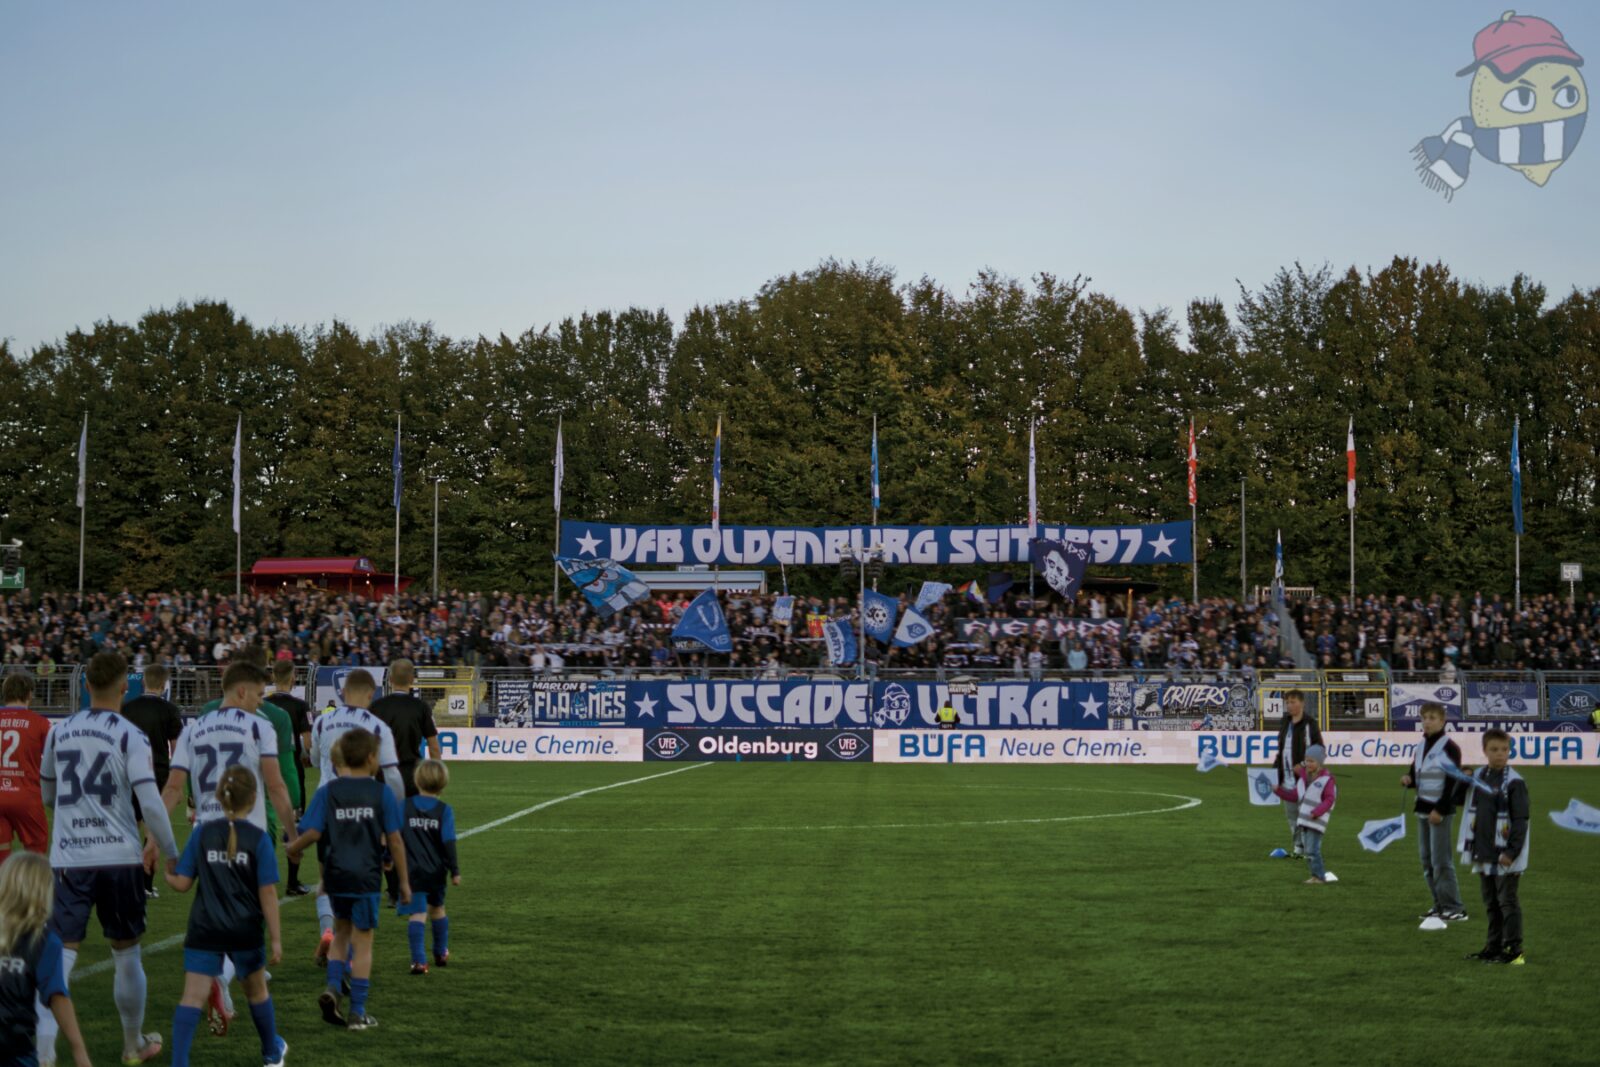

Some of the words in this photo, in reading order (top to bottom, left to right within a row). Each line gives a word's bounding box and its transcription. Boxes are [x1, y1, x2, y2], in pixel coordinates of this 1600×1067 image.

[610, 528, 684, 563] VfB
[692, 527, 938, 565] OLDENBURG
[949, 528, 1035, 564] SEIT
[532, 682, 578, 692] MARLON
[1162, 684, 1230, 706] CRITTERS
[451, 699, 465, 710] J2
[534, 691, 626, 719] FLAMES
[666, 683, 869, 724] SUCCADE
[1267, 704, 1281, 713] J1
[1569, 695, 1589, 708] VfB
[72, 729, 116, 746] OLDENBURG
[472, 735, 528, 754] Neue
[535, 735, 619, 754] Chemie.
[838, 738, 857, 750] VfB
[698, 736, 818, 759] Oldenburg
[899, 734, 986, 763] BÜFA
[1000, 737, 1055, 757] Neue
[1062, 737, 1147, 757] Chemie.
[1328, 743, 1353, 758] ue
[56, 749, 118, 807] 34
